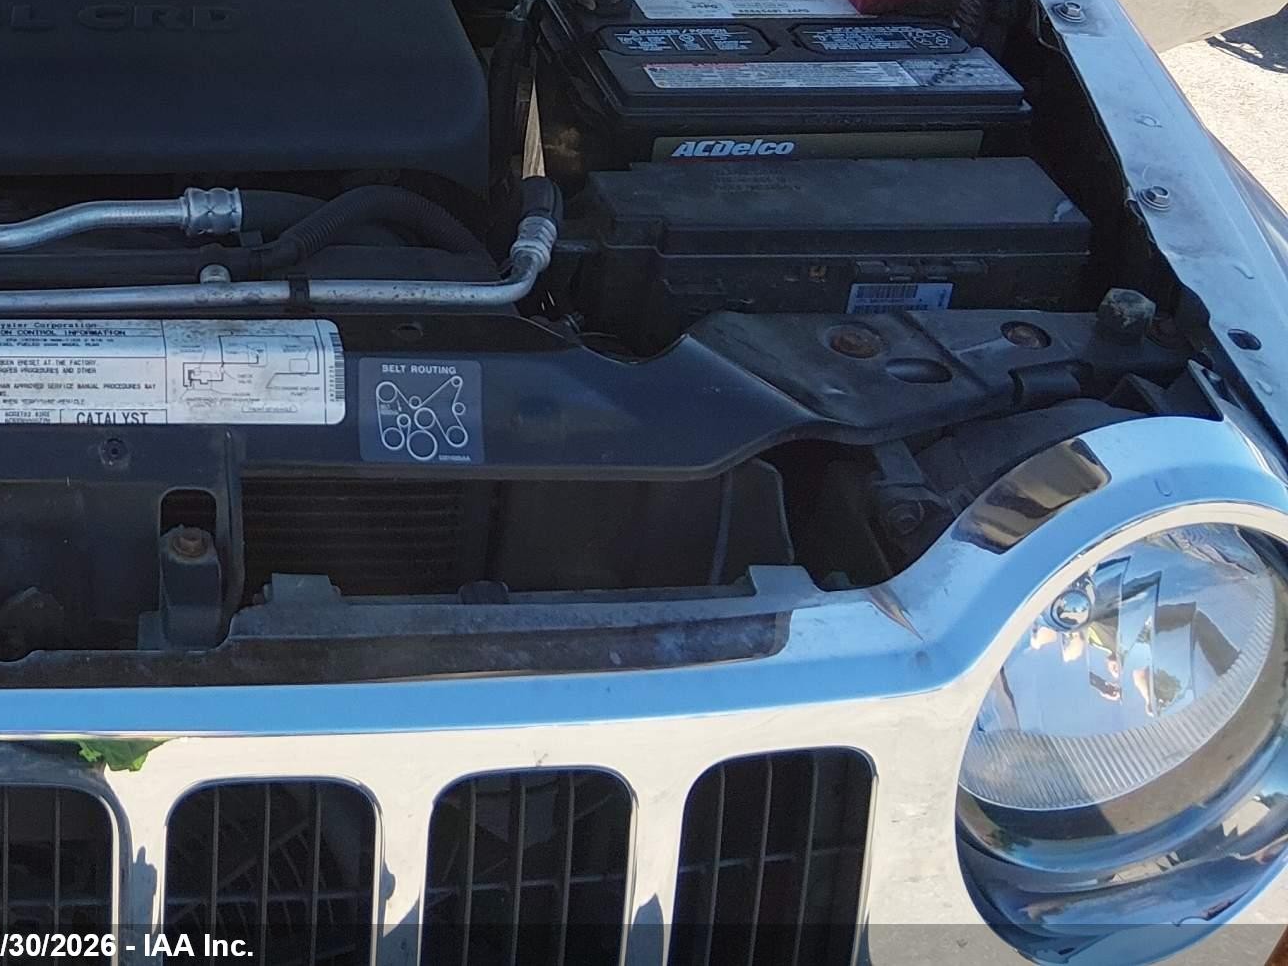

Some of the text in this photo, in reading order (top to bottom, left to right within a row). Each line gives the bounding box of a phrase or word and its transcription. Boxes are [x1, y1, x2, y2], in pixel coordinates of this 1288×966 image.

[78, 4, 241, 31] CRD
[672, 139, 795, 157] ACDelco
[381, 364, 457, 374] BELT ROUTING
[76, 412, 149, 424] CATALYST
